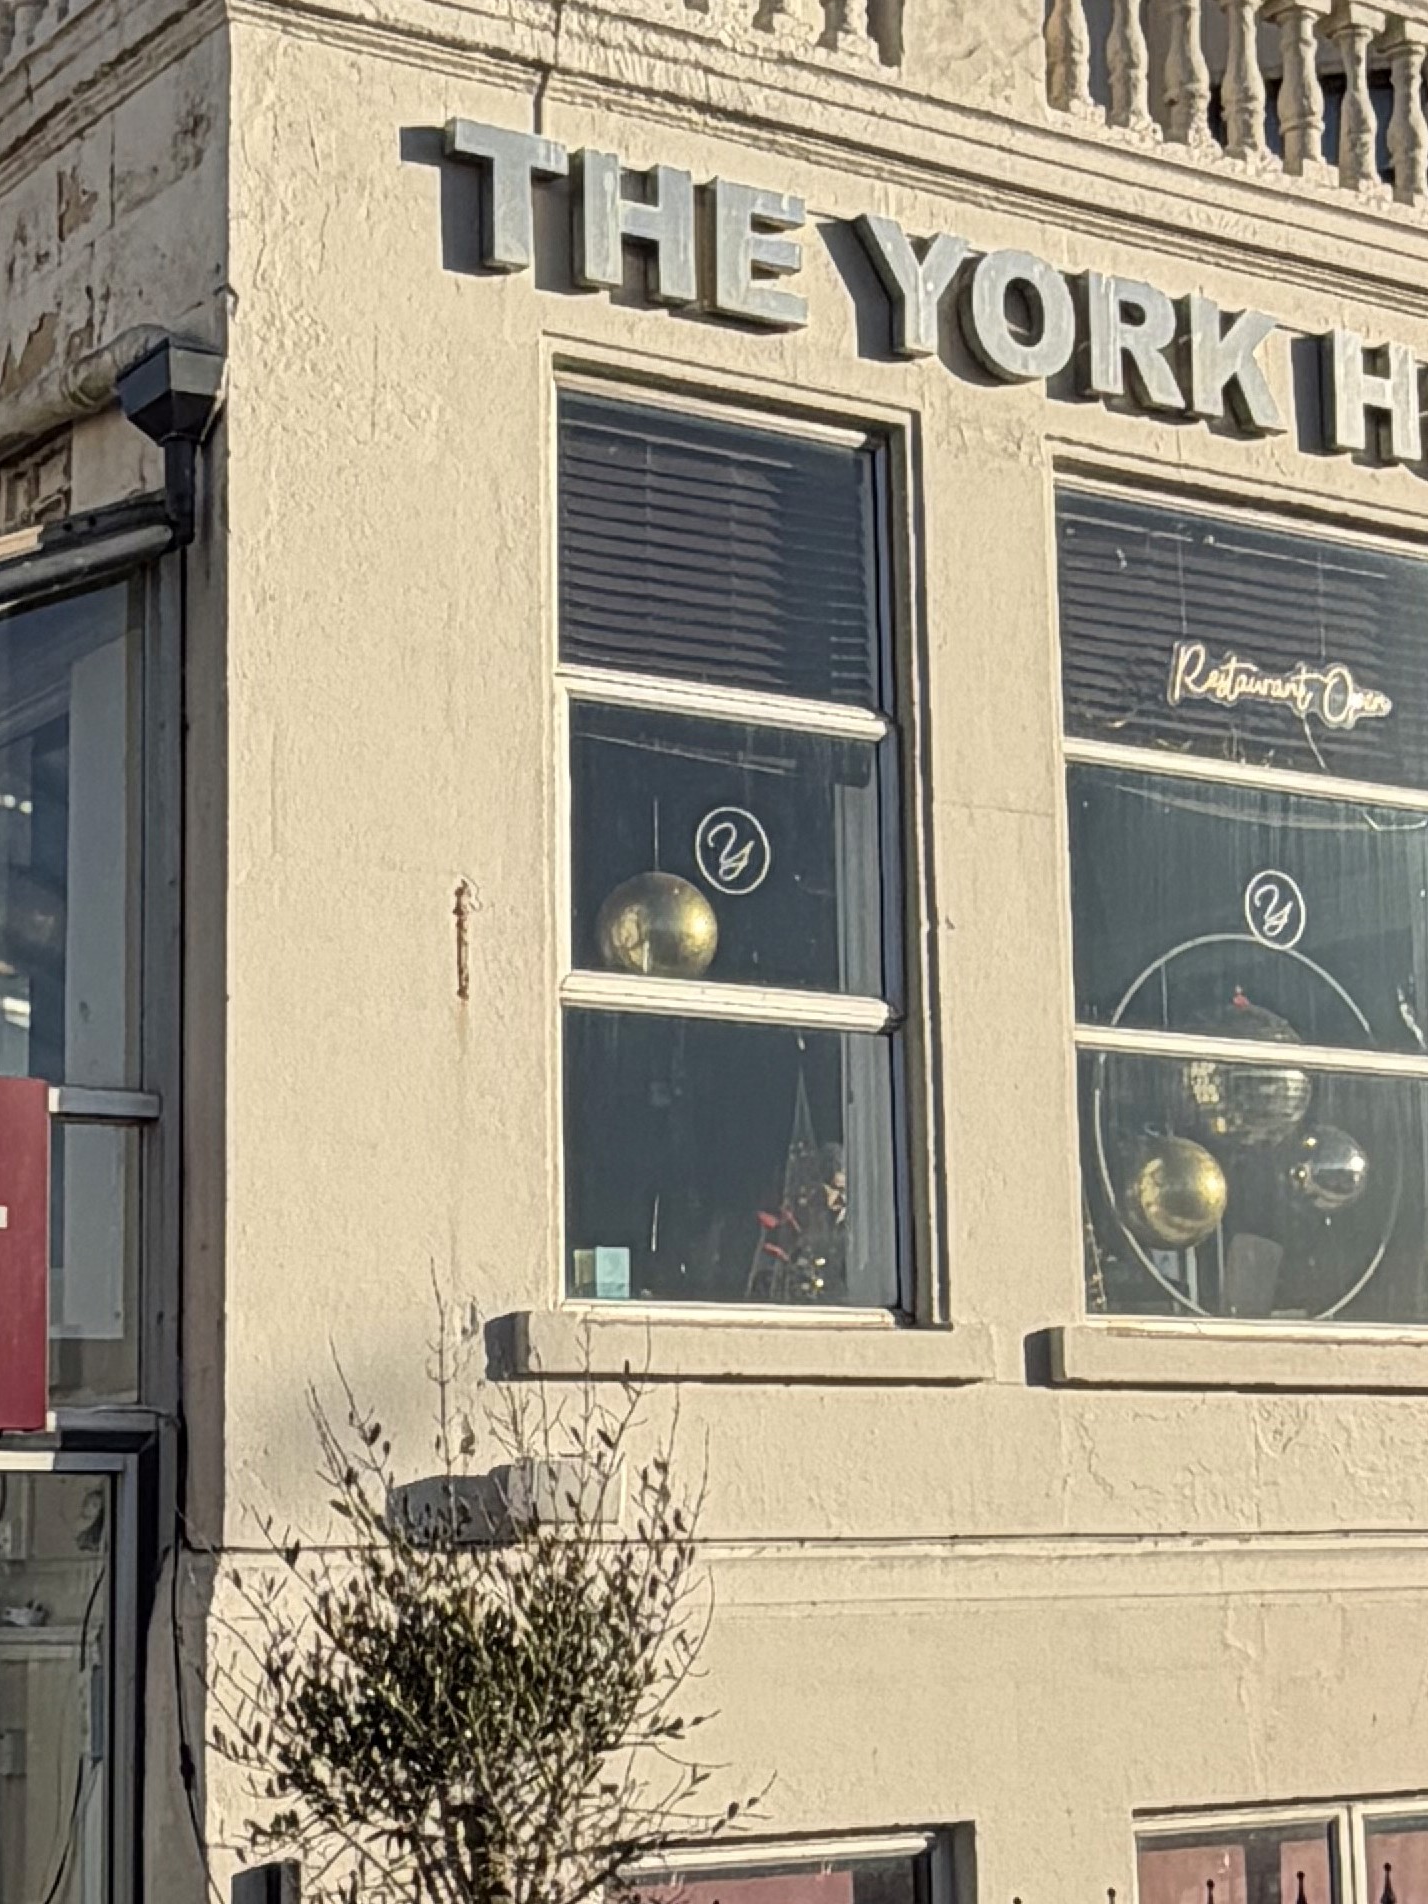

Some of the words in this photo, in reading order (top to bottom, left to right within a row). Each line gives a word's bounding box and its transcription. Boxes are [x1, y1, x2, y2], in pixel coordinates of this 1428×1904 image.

[444, 116, 809, 330] THE
[851, 213, 1289, 435] YORK
[1174, 642, 1320, 711] Restaurant
[1323, 665, 1391, 726] Open
